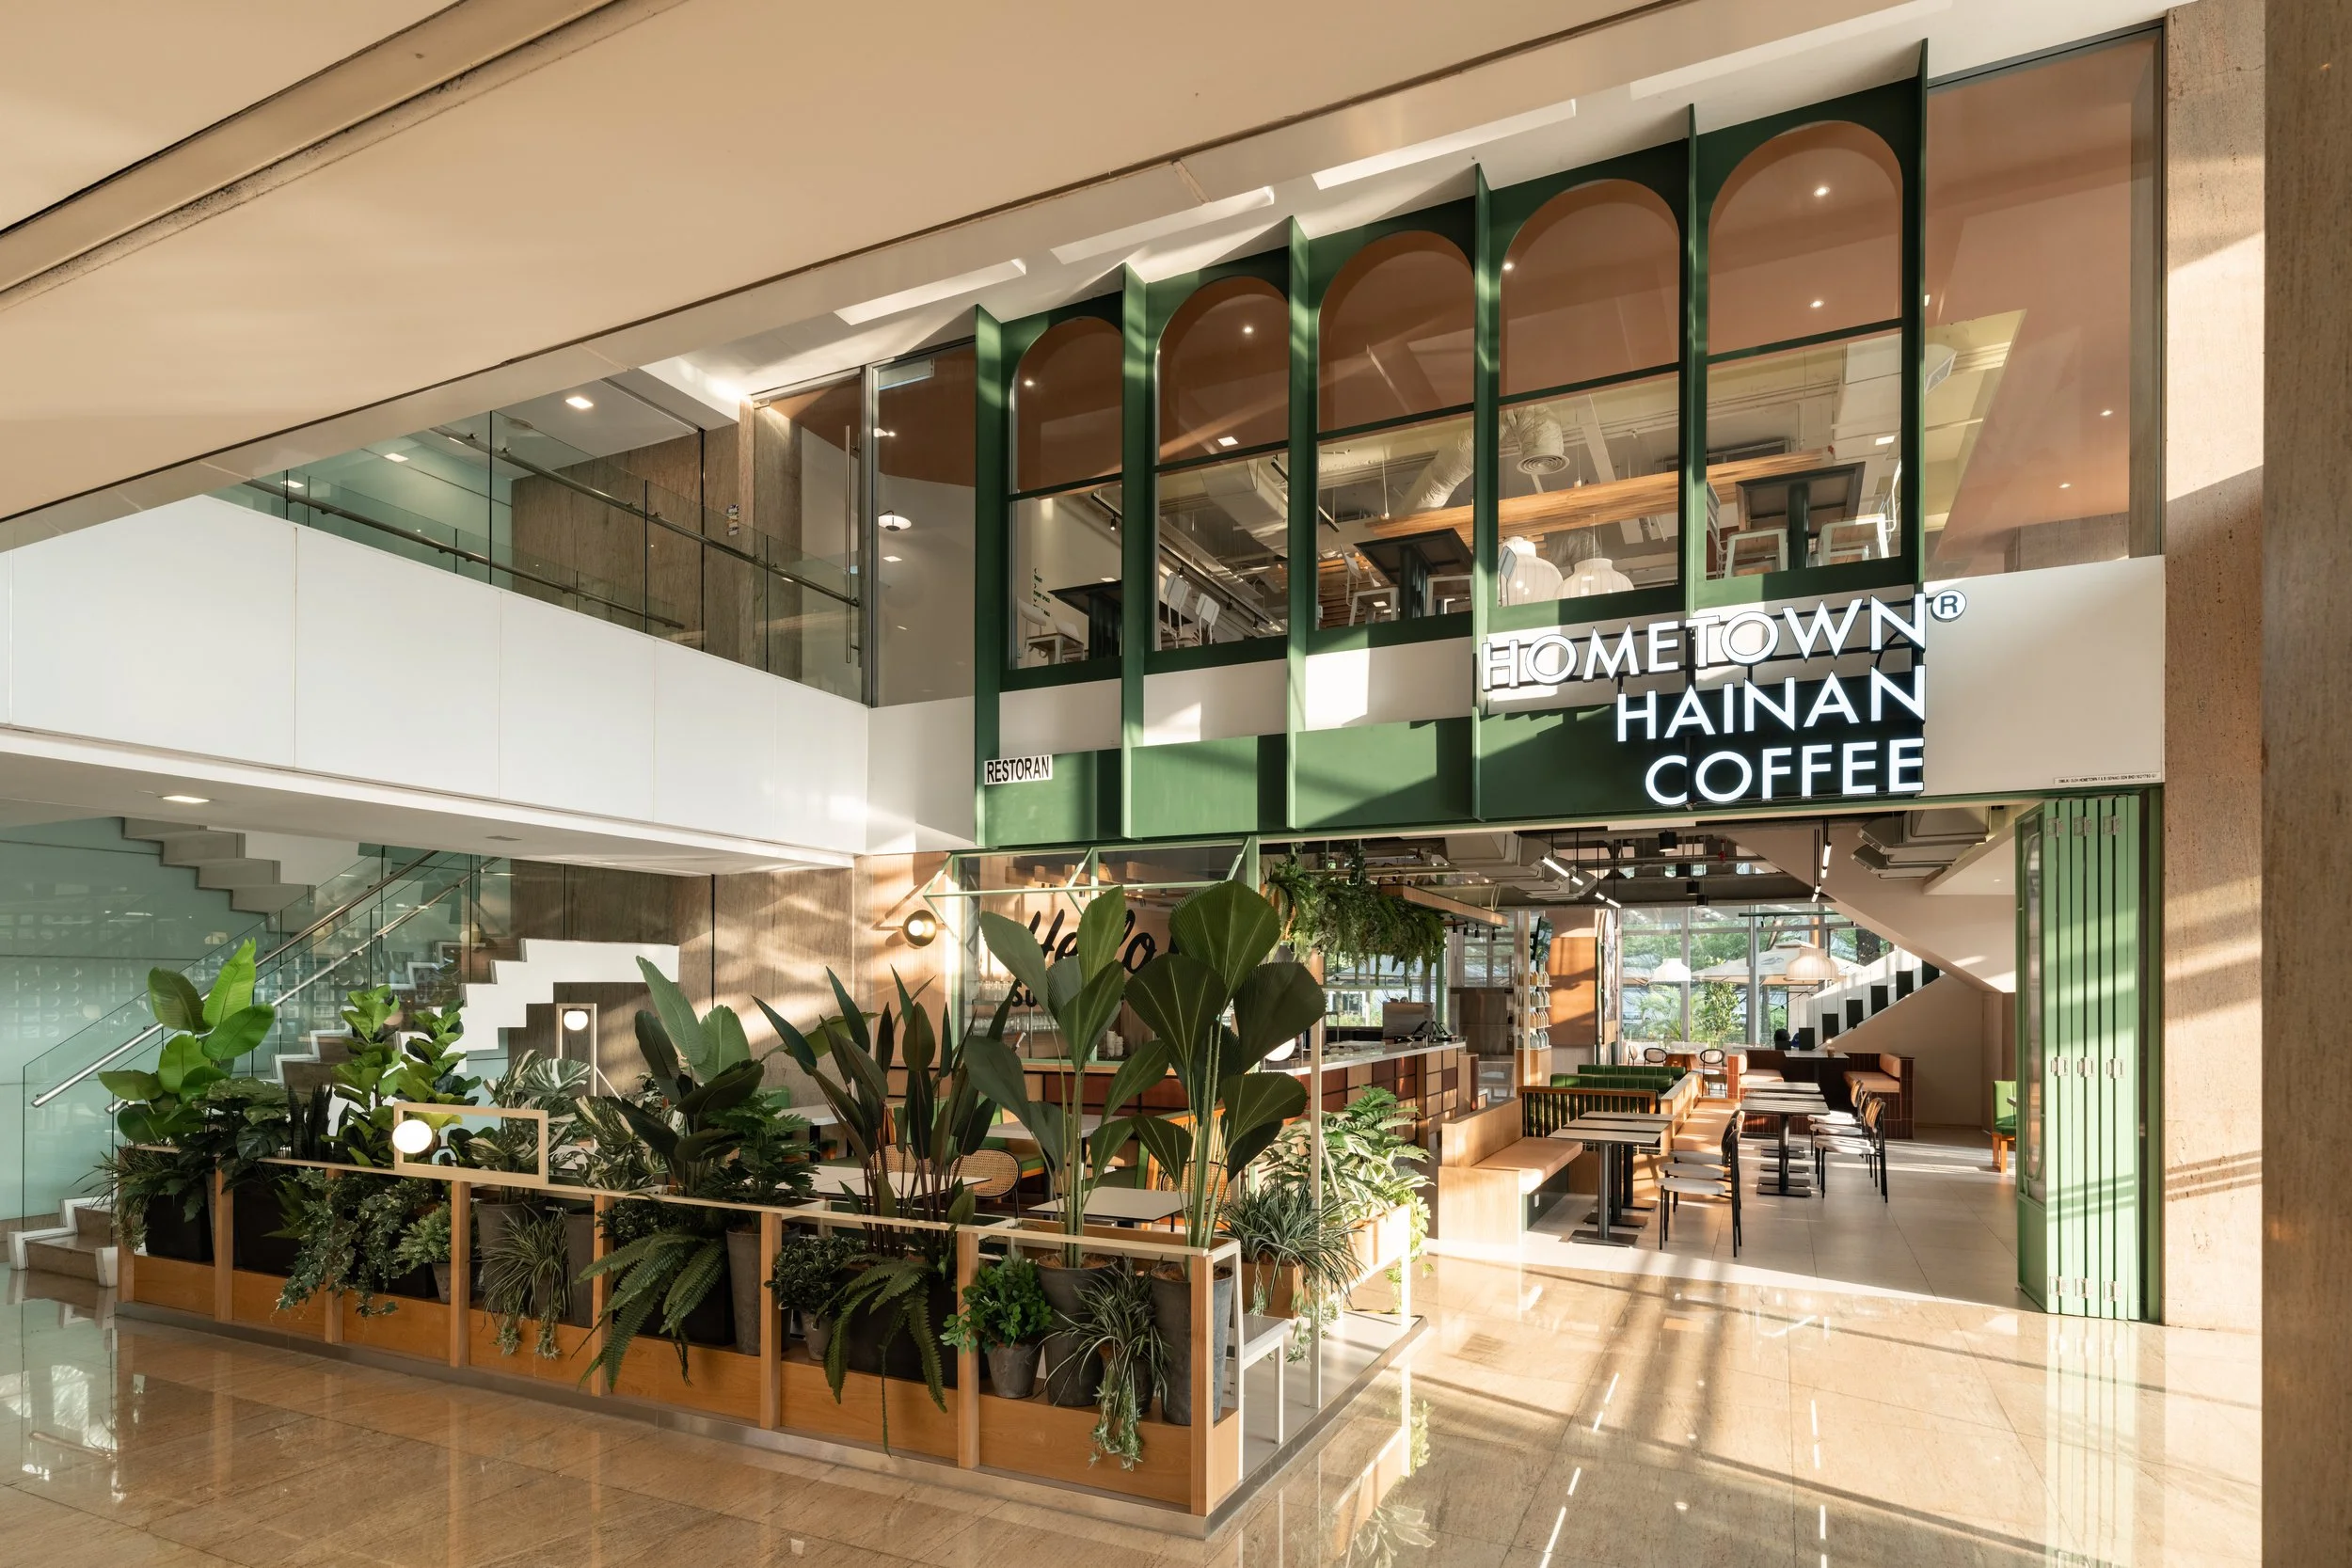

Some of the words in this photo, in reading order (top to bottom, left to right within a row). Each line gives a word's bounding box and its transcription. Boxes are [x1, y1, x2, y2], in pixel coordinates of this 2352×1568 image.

[1482, 593, 1926, 691] HOMETOWN
[1616, 664, 1926, 743] HAINAN
[987, 755, 1050, 784] RESTORAN
[1645, 737, 1925, 807] COFFEE
